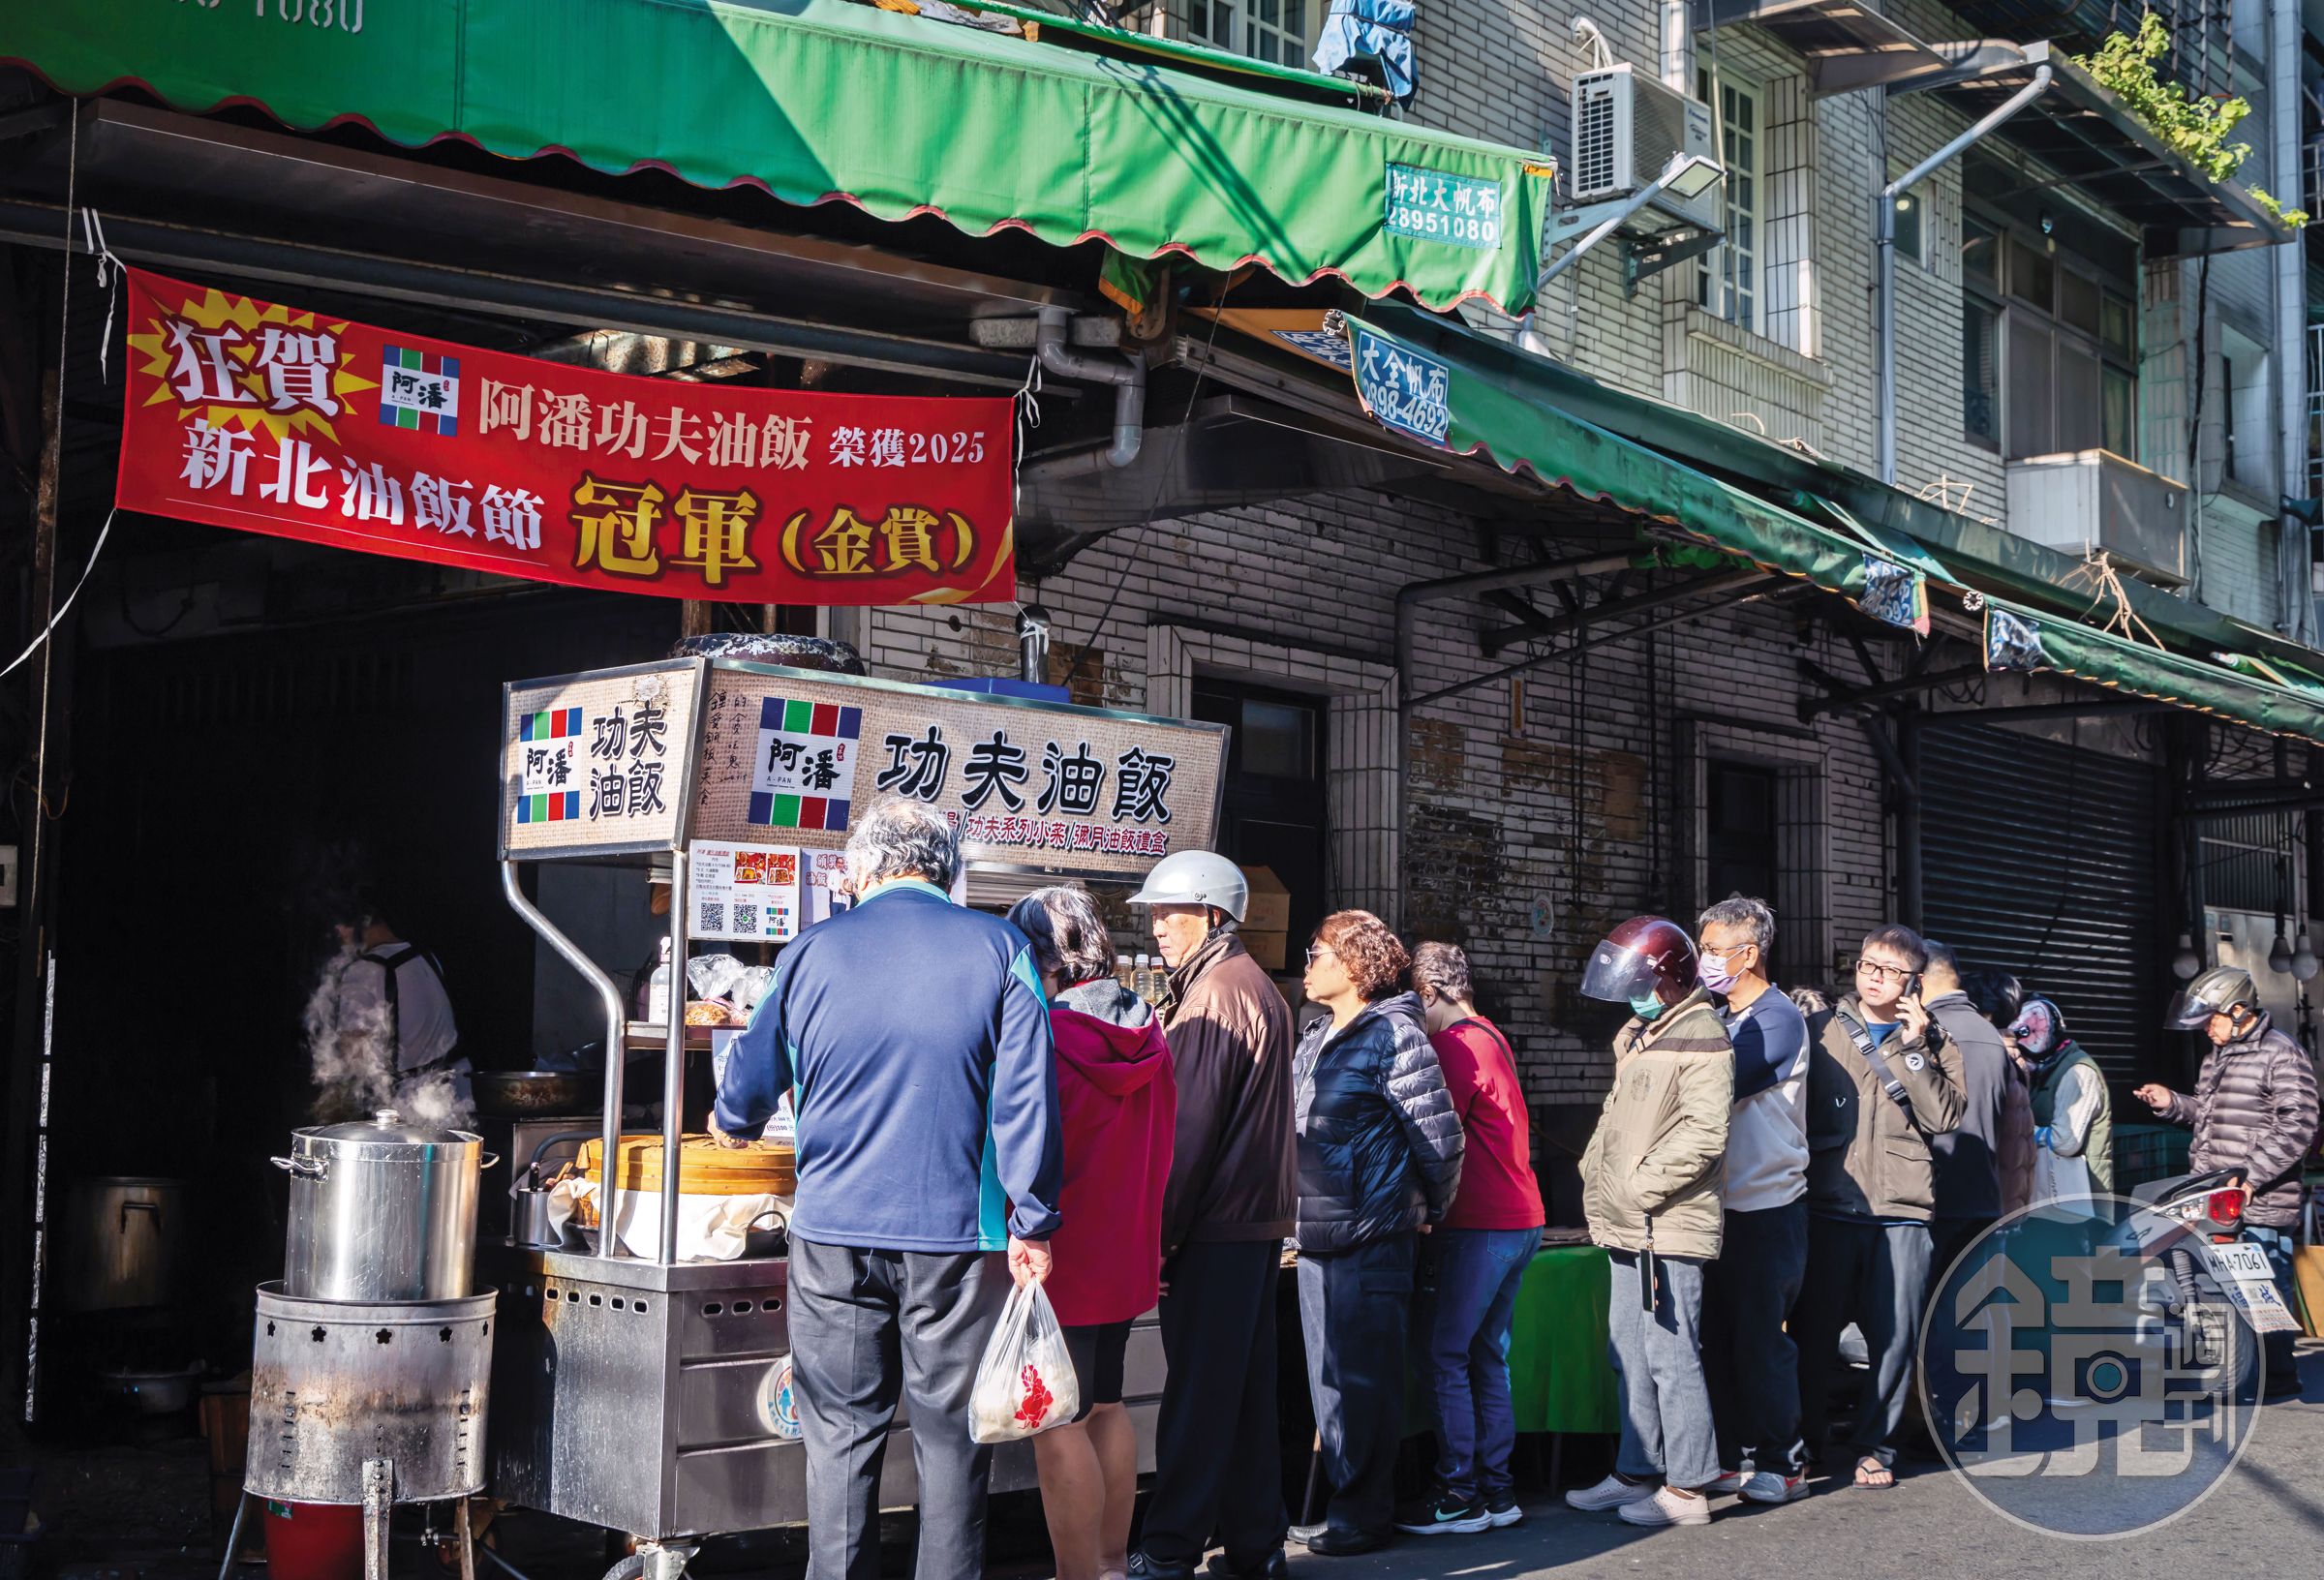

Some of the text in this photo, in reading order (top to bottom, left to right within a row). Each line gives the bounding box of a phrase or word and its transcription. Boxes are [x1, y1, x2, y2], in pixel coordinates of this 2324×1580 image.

[166, 319, 339, 416] 狂賀
[391, 371, 447, 409] 阿潘
[1361, 339, 1446, 407] 大全帆布
[478, 377, 985, 471] 阿潘功夫油飯 榮獲2025
[179, 417, 545, 551] 新北油飯節
[591, 700, 666, 759] 功夫
[527, 746, 572, 787] 阿潘
[590, 759, 666, 821] 油飯
[768, 738, 841, 790] 阿潘
[876, 726, 1174, 822] 功夫油飯
[2207, 1252, 2268, 1273] MHA-7061
